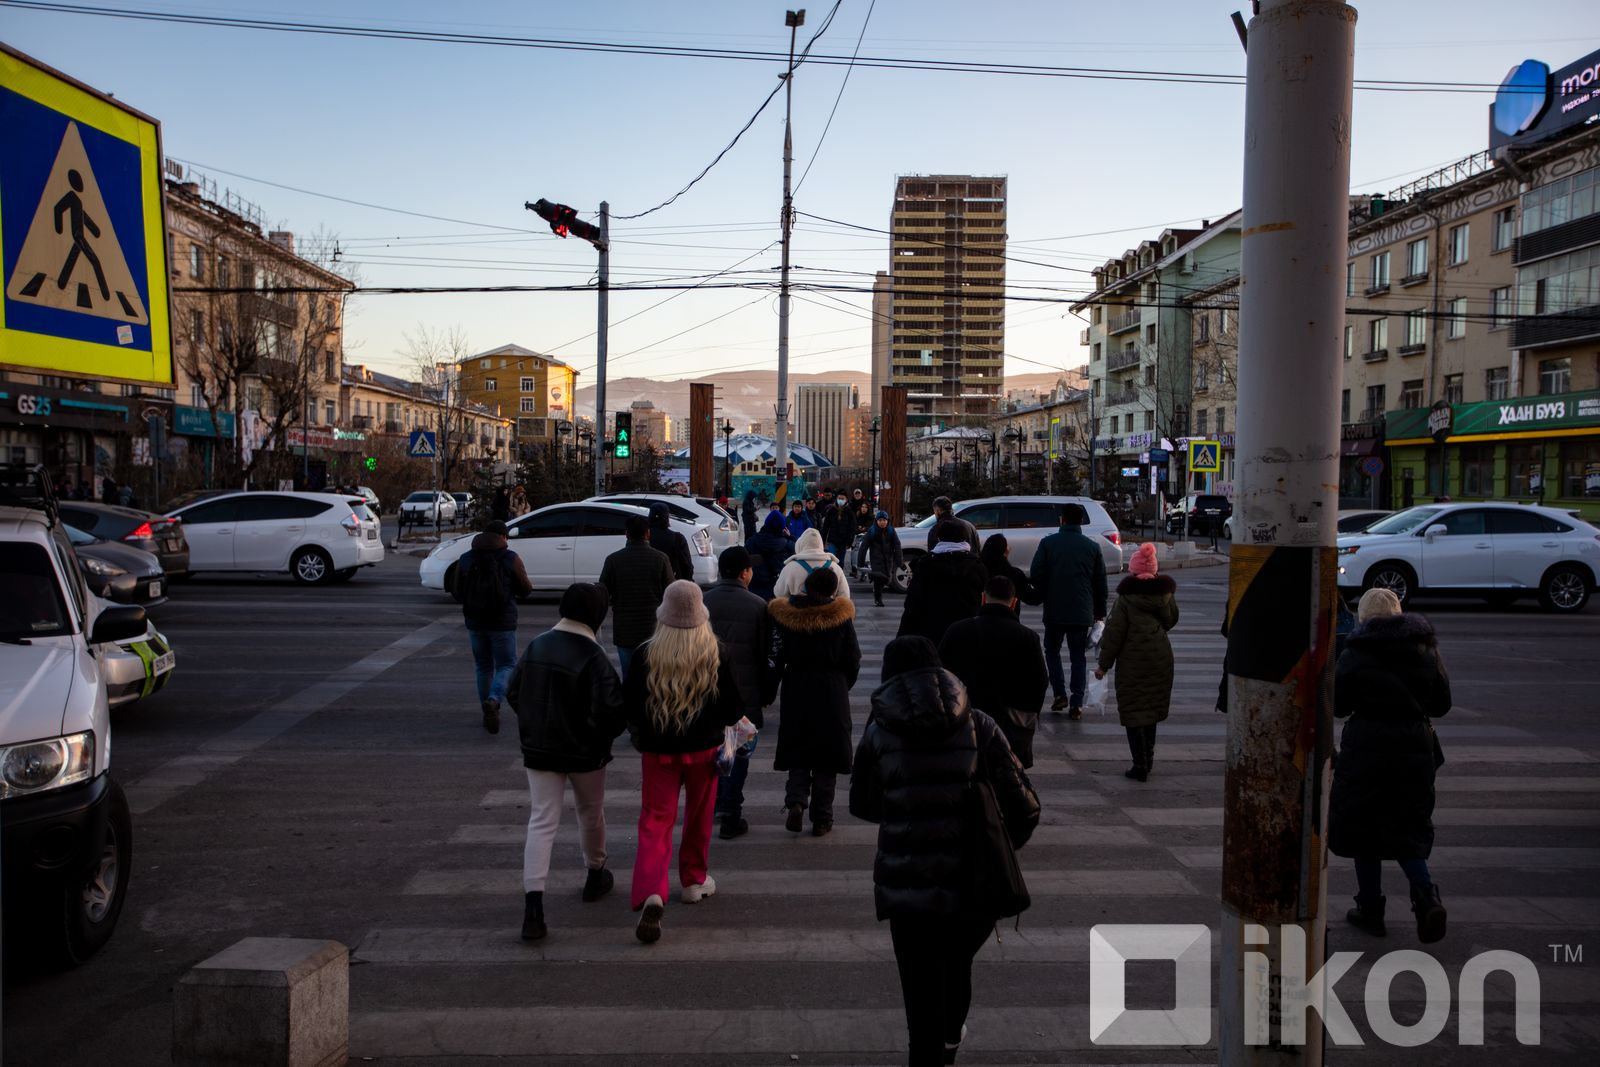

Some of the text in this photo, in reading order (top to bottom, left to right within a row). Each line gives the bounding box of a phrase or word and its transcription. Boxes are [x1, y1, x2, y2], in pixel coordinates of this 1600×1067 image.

[18, 394, 51, 416] GS25
[1498, 401, 1565, 425] ХААН БУУЗ
[616, 445, 629, 457] 25
